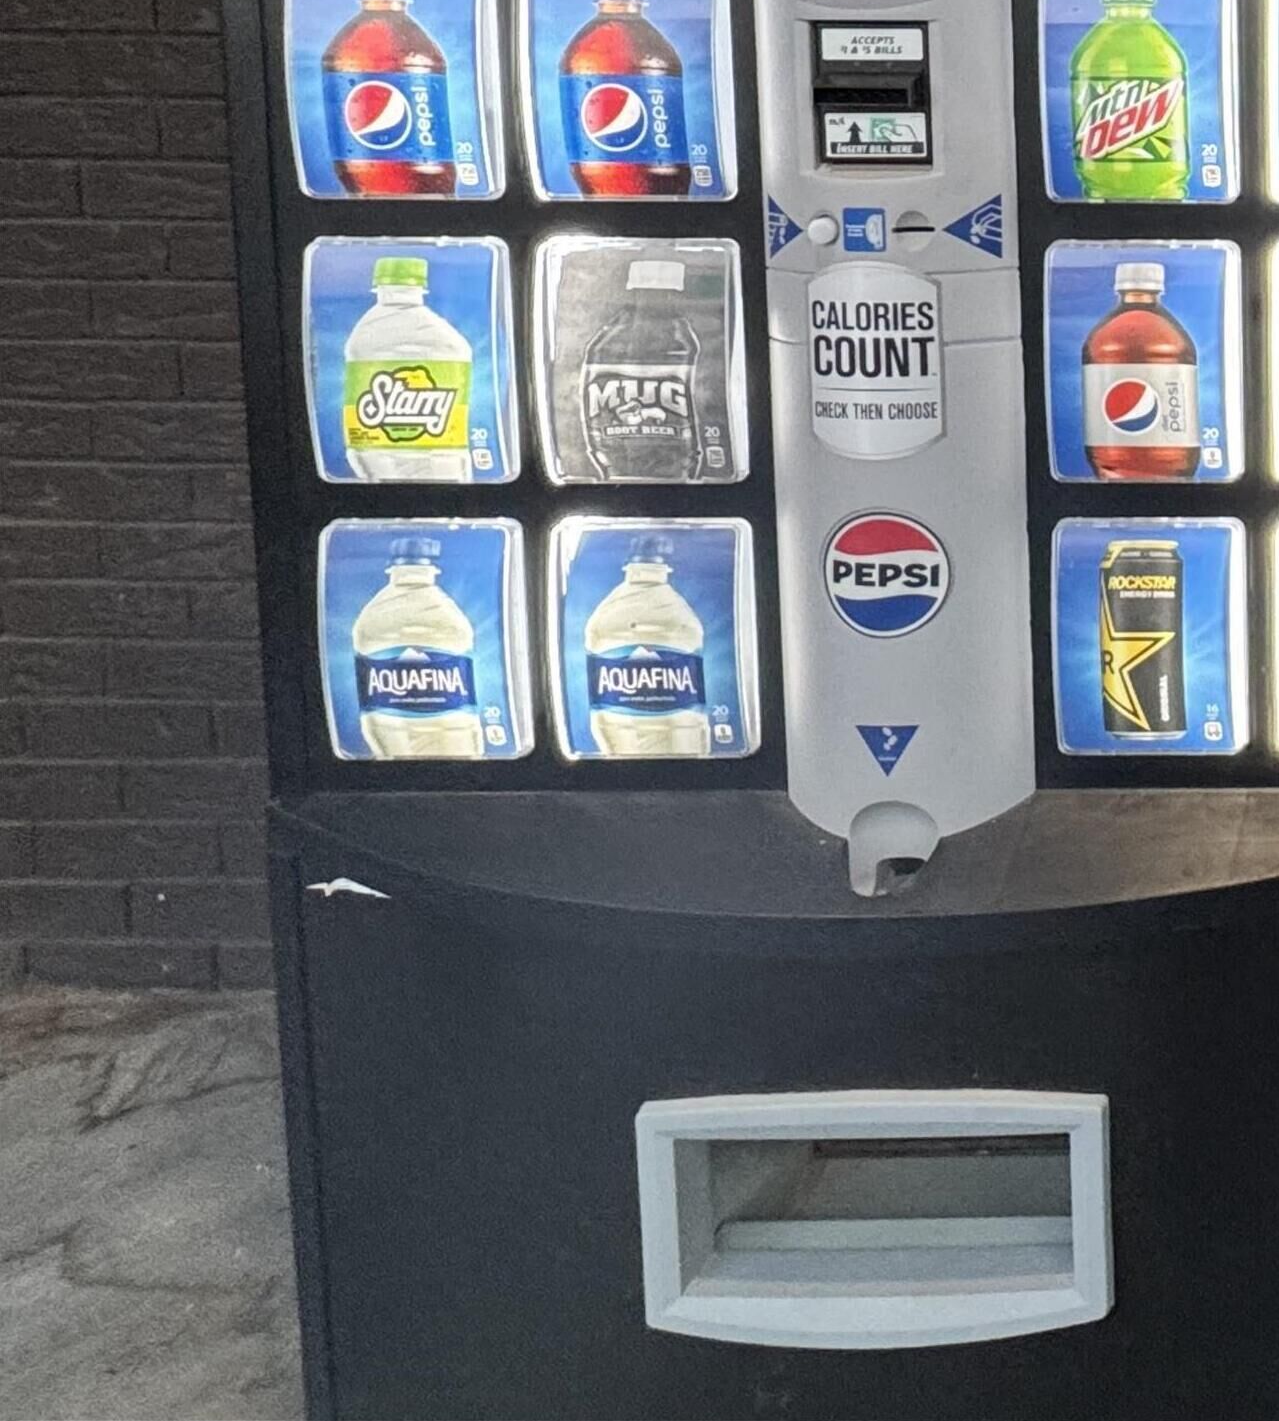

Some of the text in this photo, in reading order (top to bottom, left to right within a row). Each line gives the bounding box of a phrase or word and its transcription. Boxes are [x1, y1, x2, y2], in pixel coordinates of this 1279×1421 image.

[851, 36, 895, 45] ACCEPTS
[874, 46, 902, 55] BILLS
[410, 86, 437, 147] pepsi
[647, 88, 672, 149] pepsi
[456, 141, 473, 154] 20
[691, 143, 708, 156] 20
[1202, 144, 1218, 157] 20
[812, 300, 934, 331] CALORIES
[358, 373, 456, 436] Starry
[588, 380, 689, 417] MUG
[815, 401, 938, 420] CHECK THEN CHOOSE
[1165, 381, 1182, 433] pepsi
[471, 428, 487, 440] 20
[606, 426, 675, 436] ROOT BEER
[704, 426, 720, 438] 20
[1203, 427, 1219, 440] 20
[833, 559, 939, 587] PEPSI
[1108, 575, 1176, 590] ROCKSTAR
[368, 667, 468, 696] AQUAFINA
[598, 666, 697, 695] AQUAFINA
[484, 705, 501, 718] 20
[712, 704, 729, 716] 20
